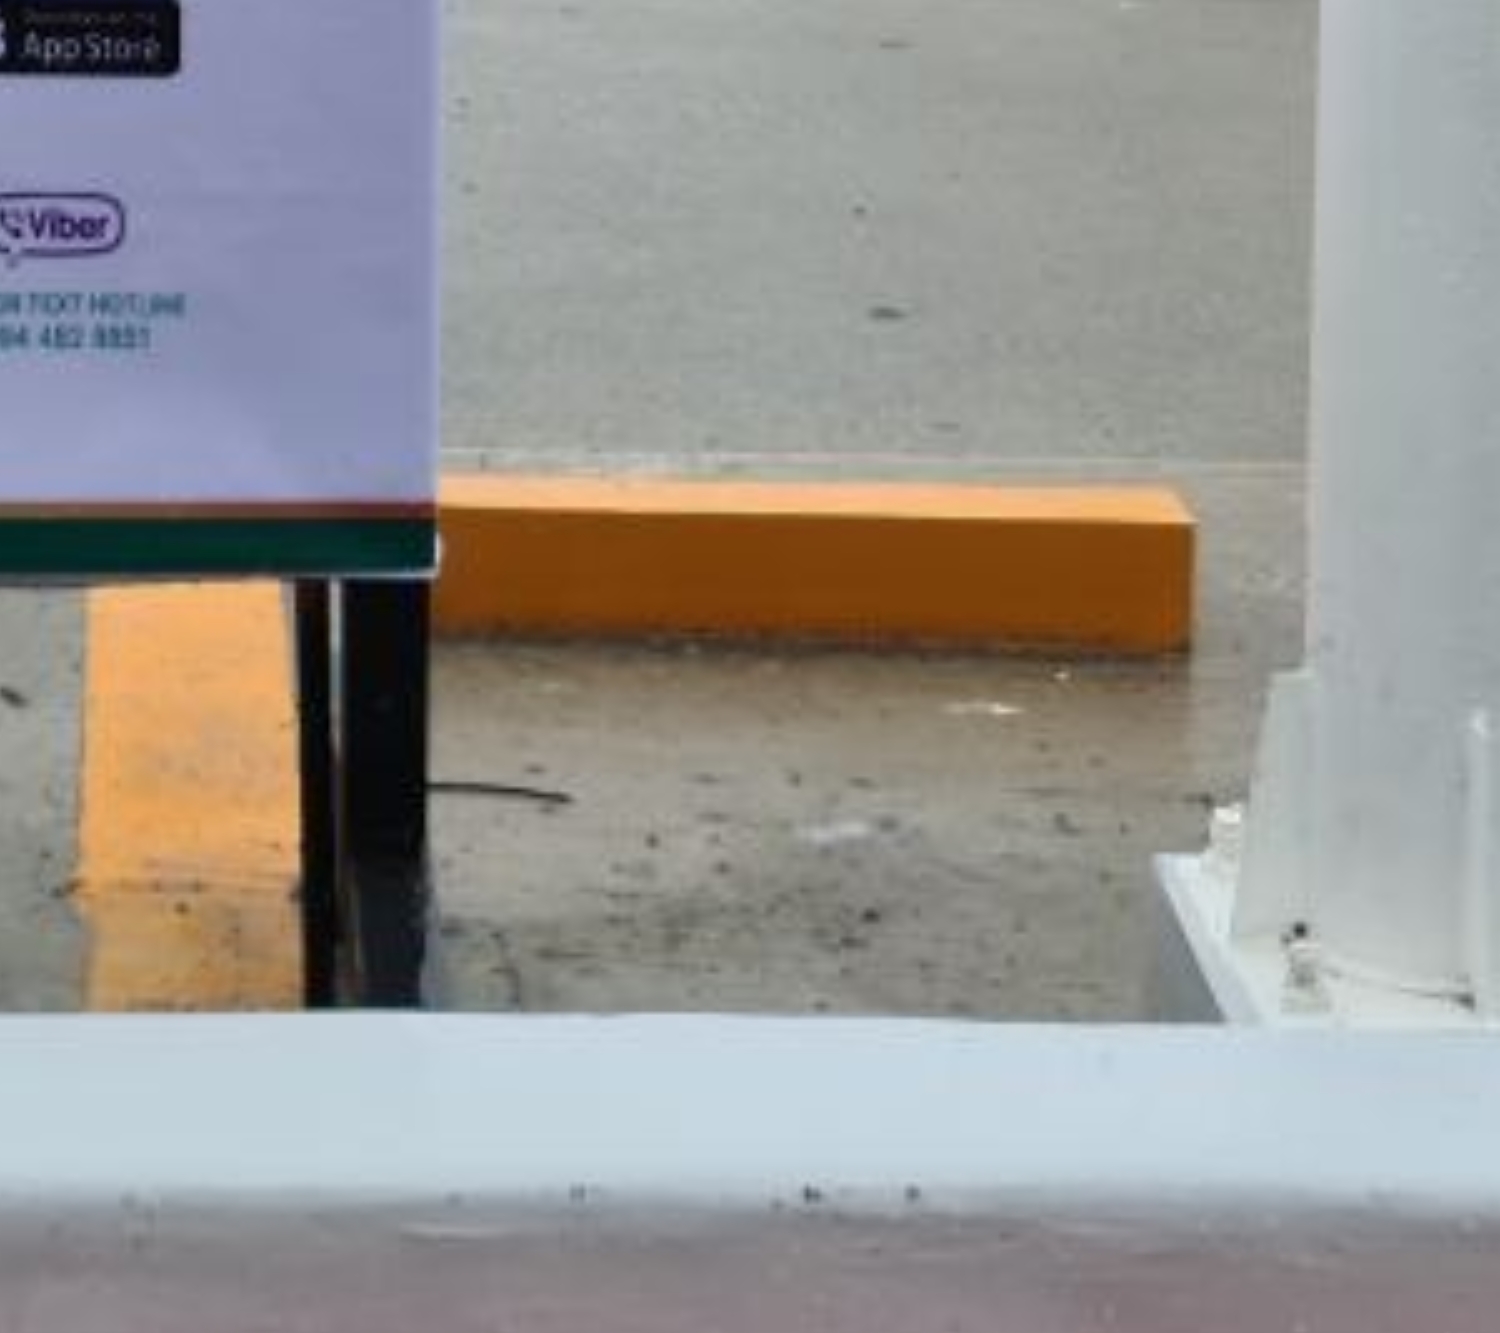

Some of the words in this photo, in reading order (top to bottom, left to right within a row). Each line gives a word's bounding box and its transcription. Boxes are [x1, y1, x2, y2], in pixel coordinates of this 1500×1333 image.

[21, 33, 81, 65] App
[85, 31, 162, 62] Store
[28, 209, 110, 240] Viber
